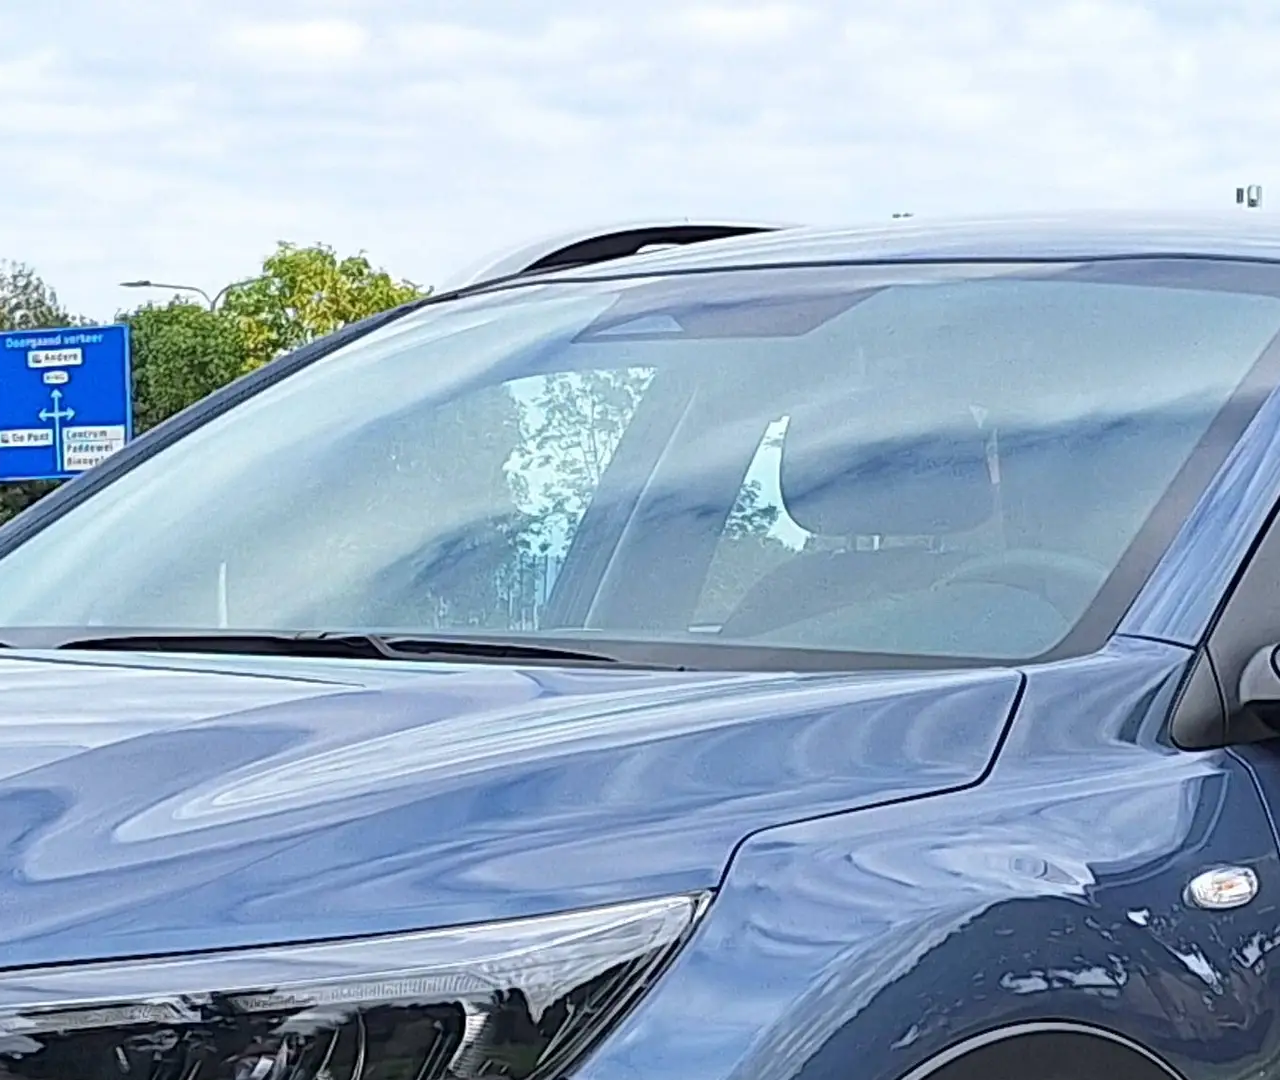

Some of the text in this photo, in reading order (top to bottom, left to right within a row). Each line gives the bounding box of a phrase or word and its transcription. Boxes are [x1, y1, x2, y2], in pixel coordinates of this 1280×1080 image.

[5, 333, 104, 349] Doorgaand verkeer
[44, 352, 78, 362] Andere
[66, 430, 107, 440] Centrum
